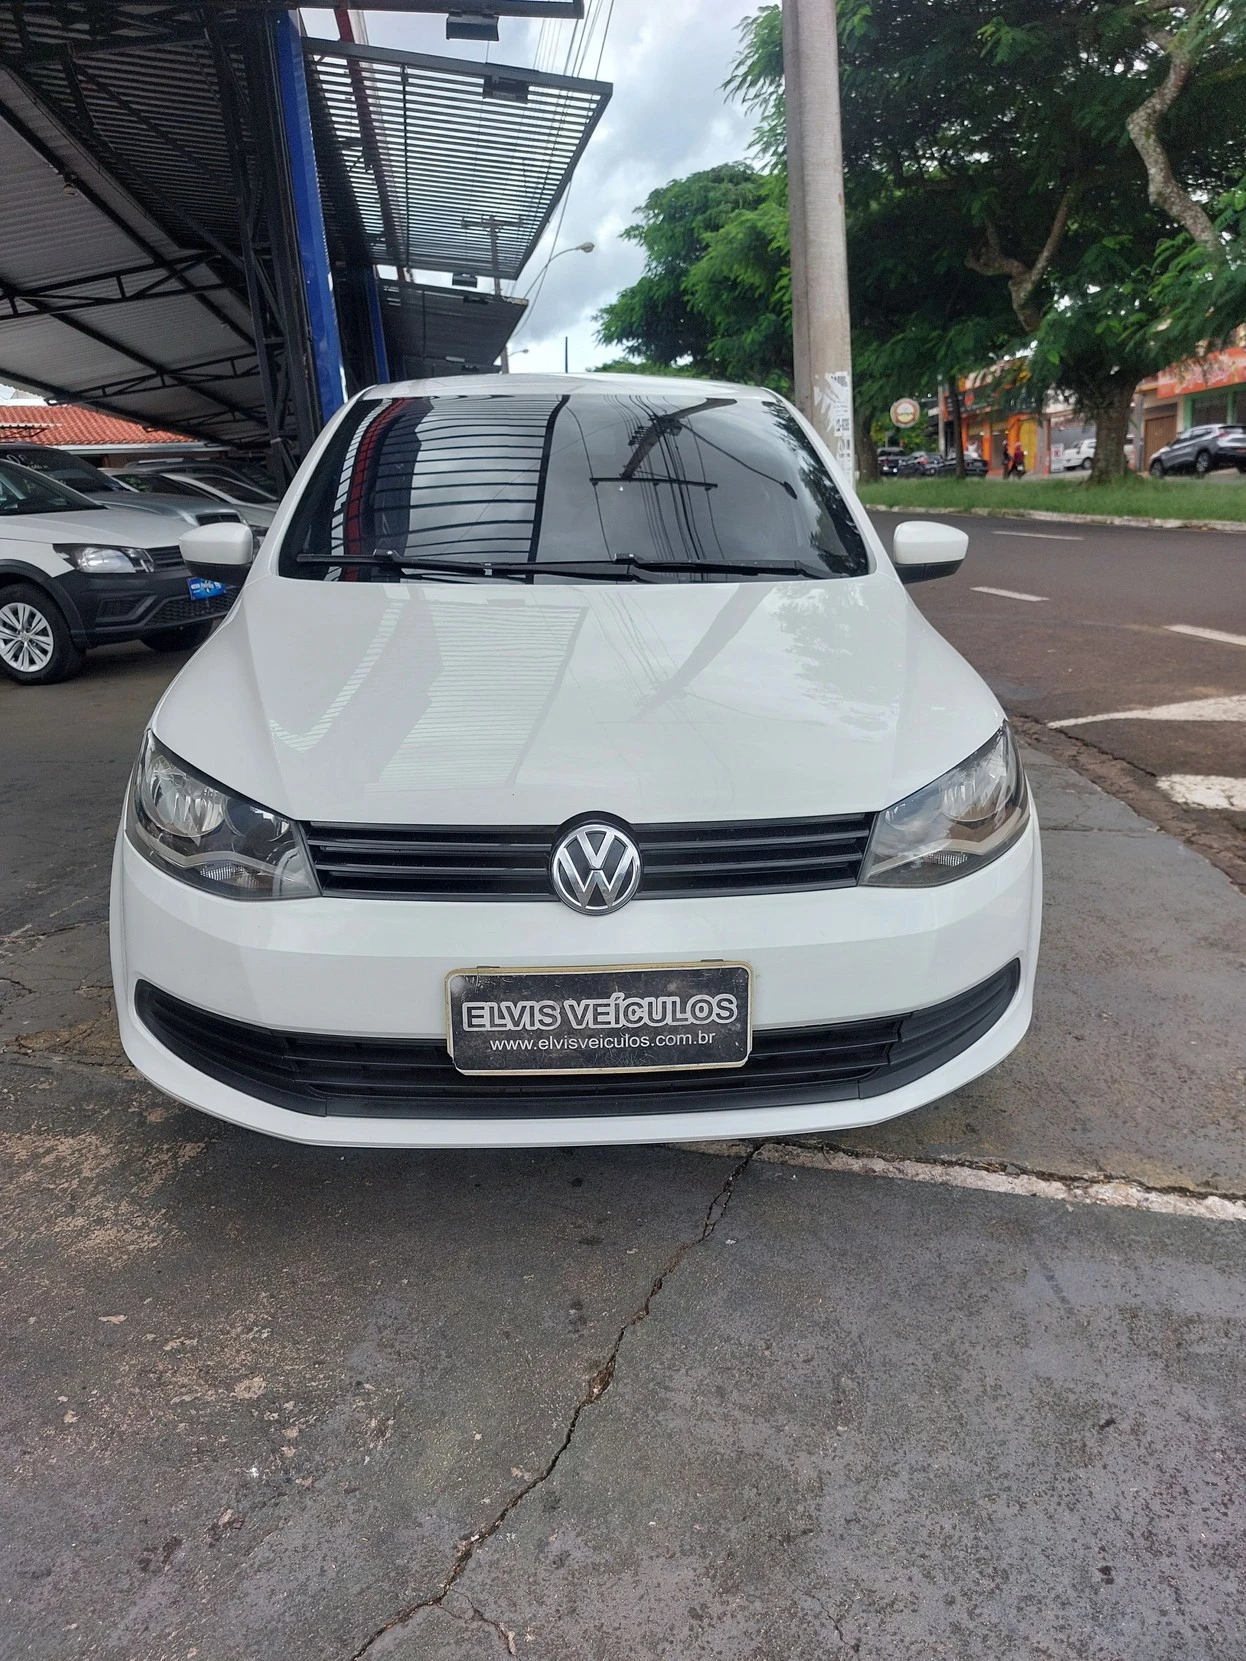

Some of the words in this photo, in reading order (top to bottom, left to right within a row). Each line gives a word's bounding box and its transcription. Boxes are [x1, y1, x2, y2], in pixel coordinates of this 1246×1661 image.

[555, 827, 638, 910] VW
[462, 1001, 562, 1031] ELVIS
[566, 992, 738, 1029] VEÍCULOS
[489, 1030, 716, 1051] www.elvisveiculos.com.br
